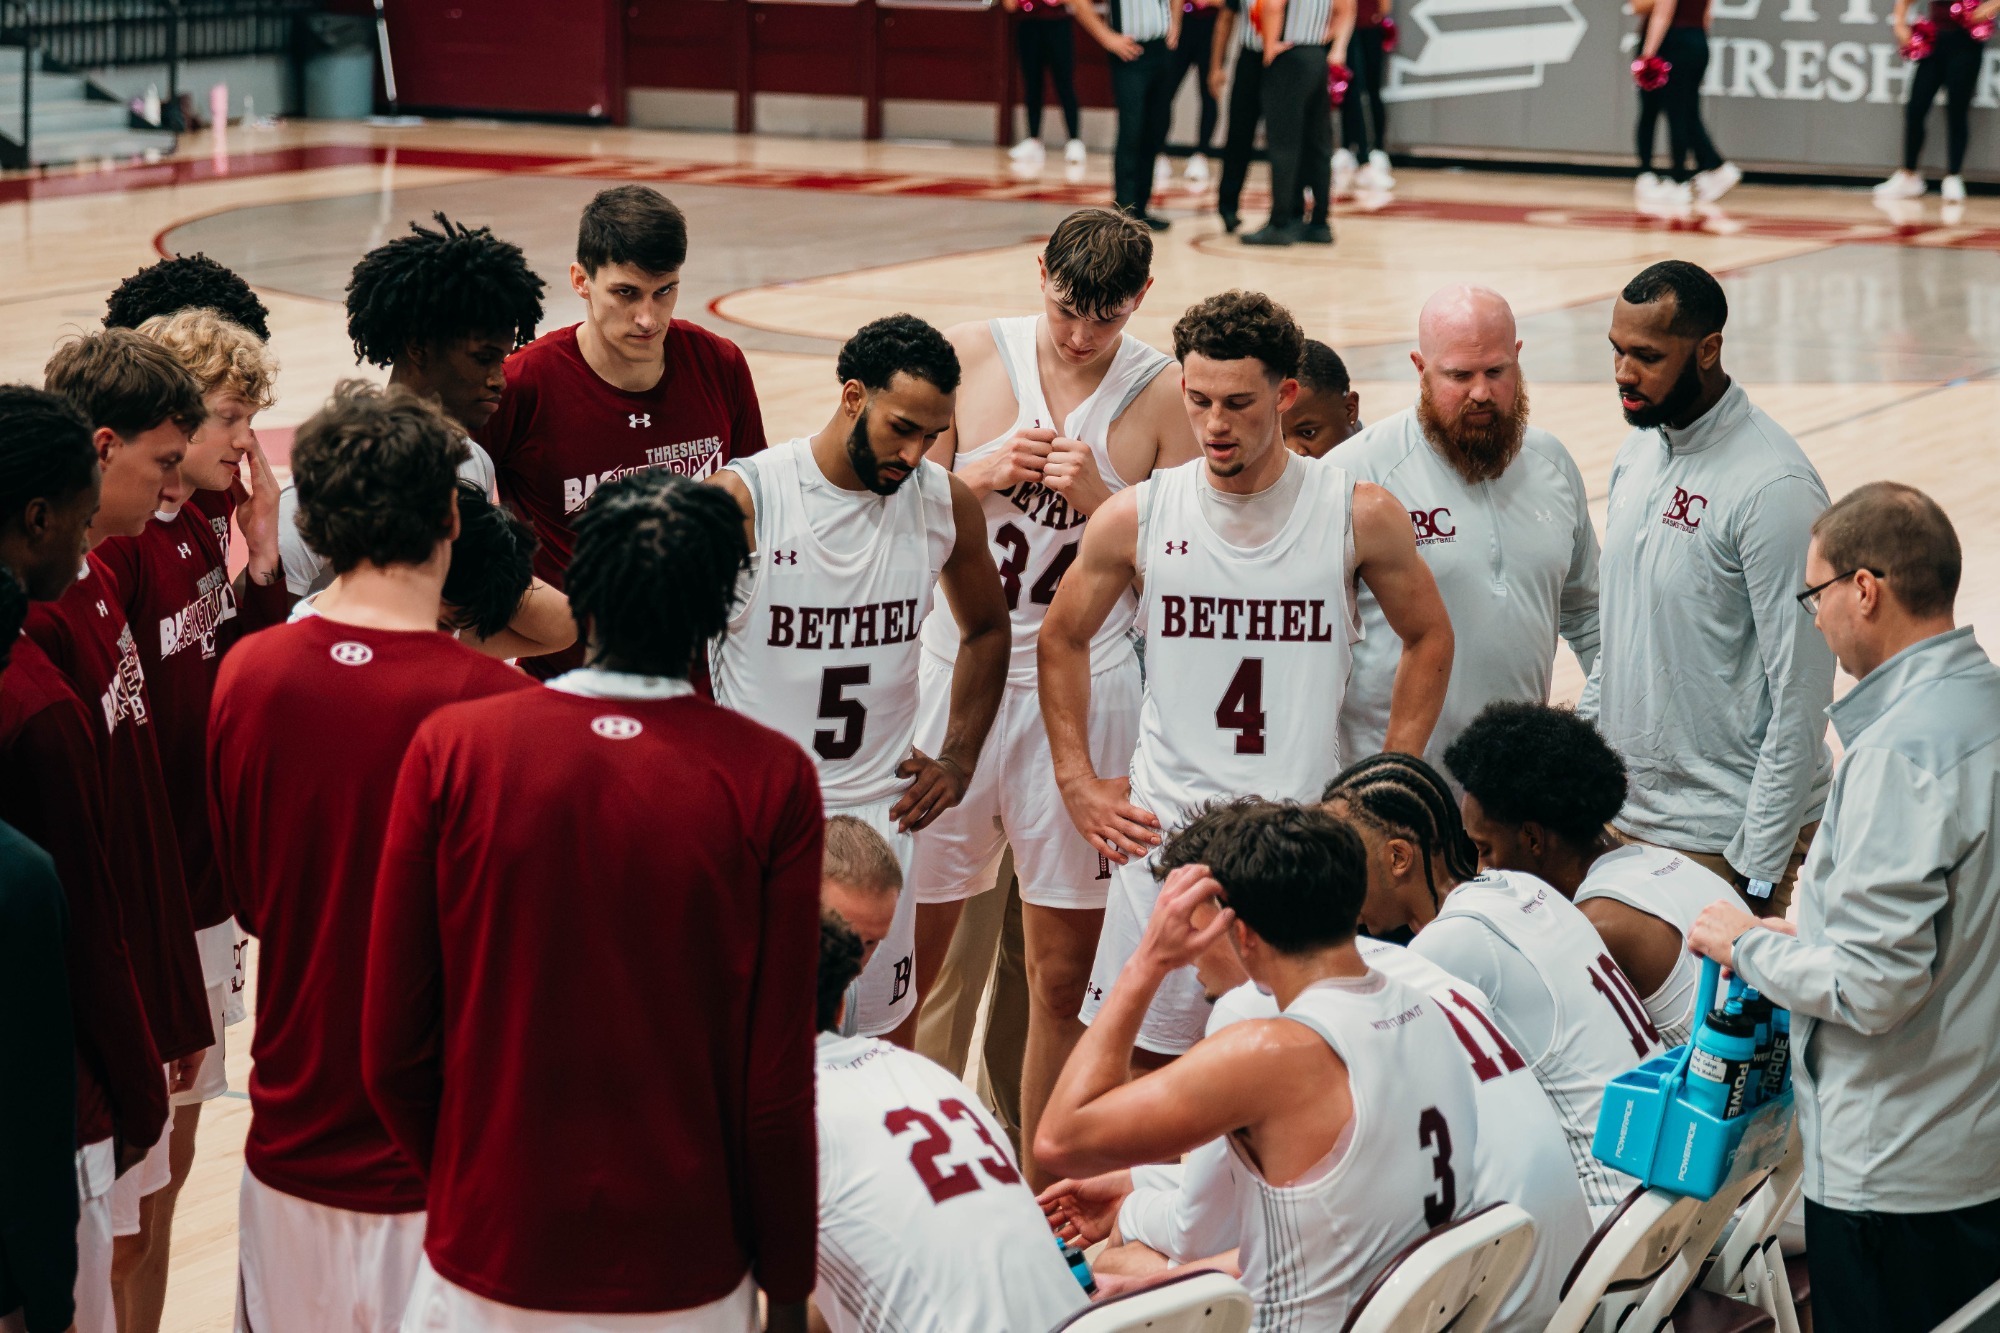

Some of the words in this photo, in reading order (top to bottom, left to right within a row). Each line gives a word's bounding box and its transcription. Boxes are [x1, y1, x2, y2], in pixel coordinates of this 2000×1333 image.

[645, 435, 721, 464] THRESHERS
[1415, 536, 1456, 547] BASKETBALL
[1661, 517, 1697, 535] BASKETBALL
[994, 520, 1080, 613] 34
[767, 598, 923, 649] BETHEL
[1161, 594, 1332, 642] BETHEL
[812, 663, 871, 761] 5
[1214, 656, 1267, 756] 4
[1429, 988, 1527, 1083] 11
[1585, 952, 1661, 1060] 10
[883, 1097, 1022, 1206] 23
[1418, 1105, 1456, 1230] 3
[1615, 1099, 1635, 1159] POWERADE
[1677, 1121, 1698, 1182] POWERADE
